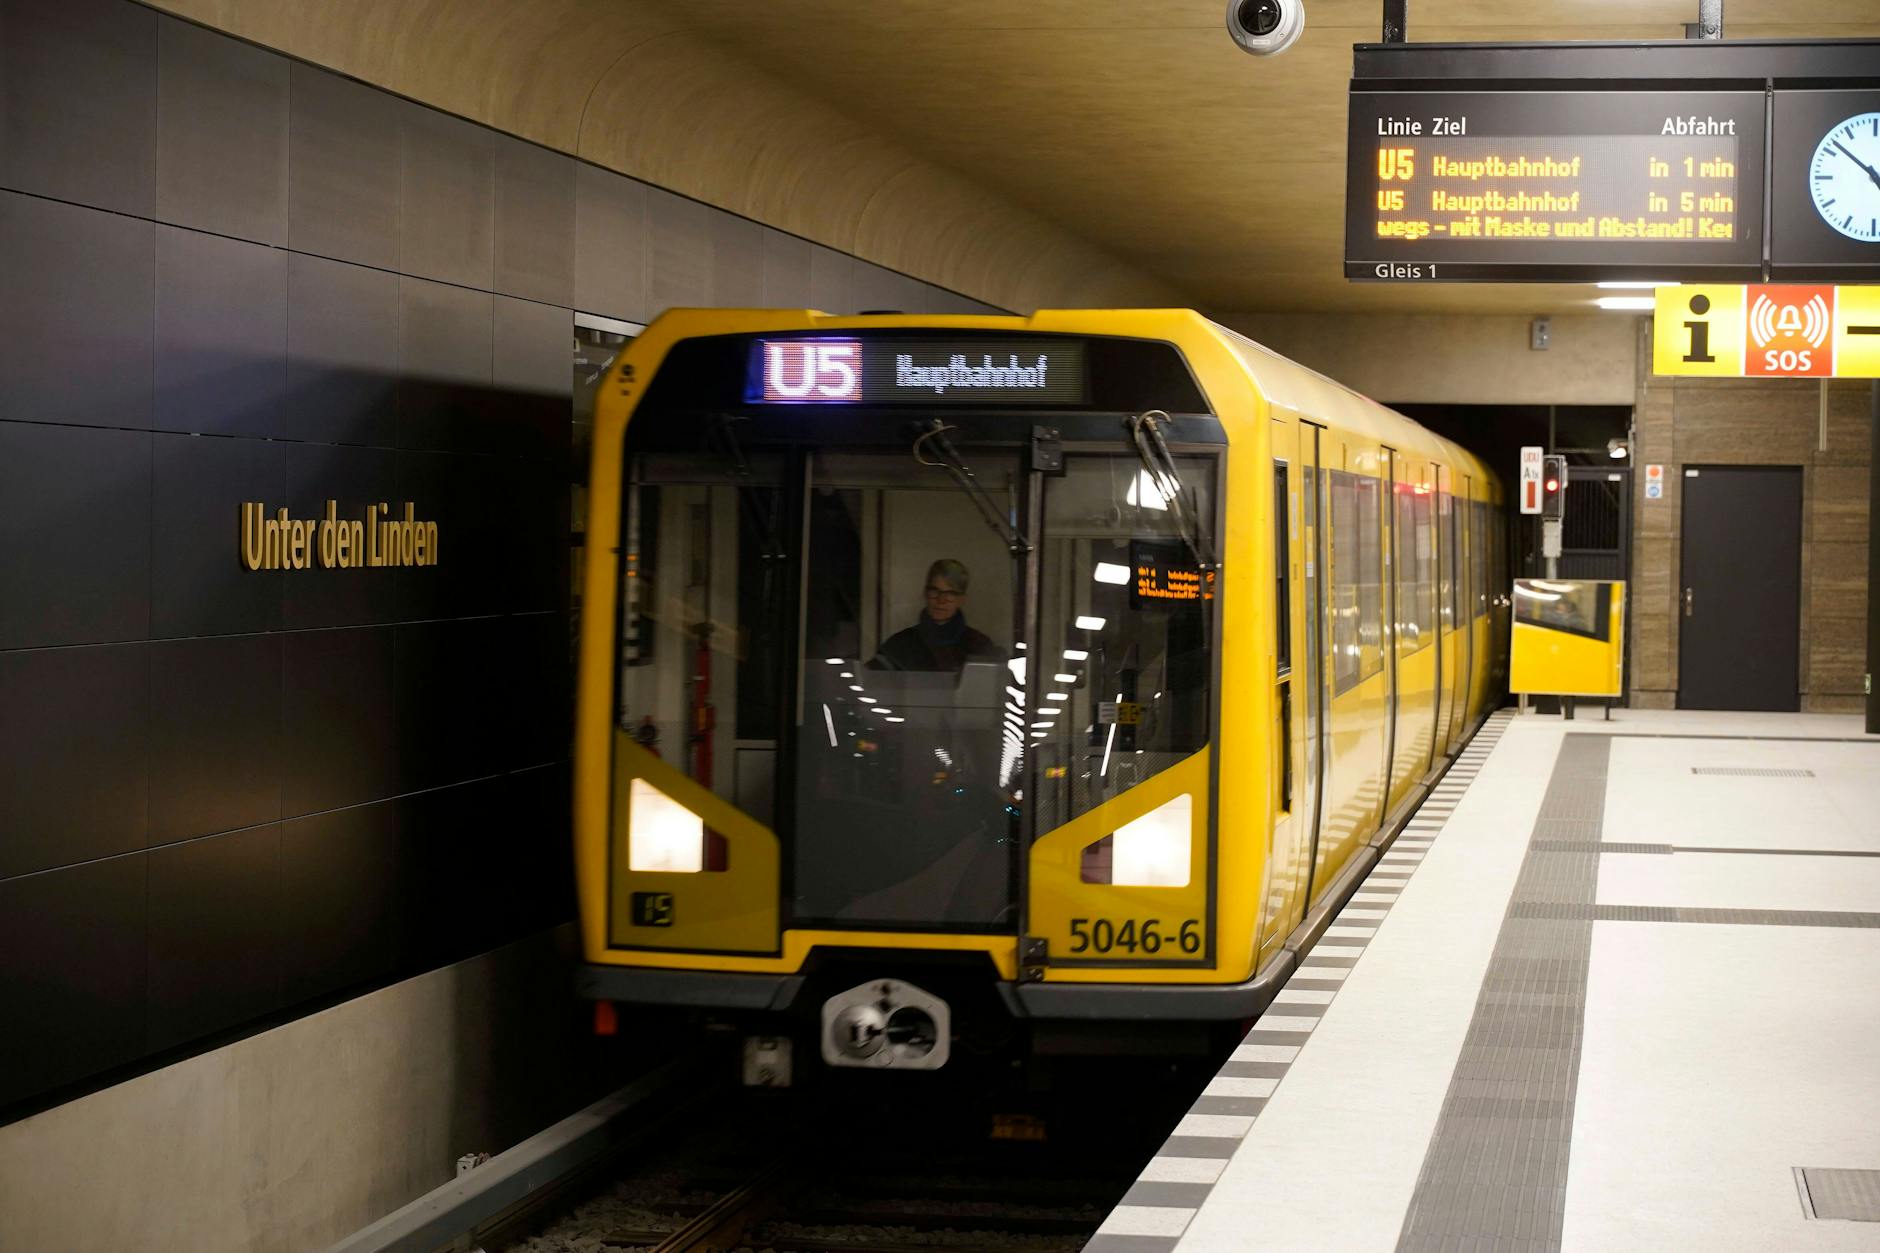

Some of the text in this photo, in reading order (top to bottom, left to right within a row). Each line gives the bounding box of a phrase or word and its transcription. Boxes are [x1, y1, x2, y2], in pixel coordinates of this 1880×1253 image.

[1378, 116, 1736, 135] Linie Ziel Abfahrt
[1378, 149, 1735, 180] U5 Hauptbahnhof in 1 min
[1377, 190, 1734, 214] U5 Hauptbahnhof in 5 min
[1377, 221, 1431, 240] wegs
[1450, 216, 1481, 237] mit
[1485, 216, 1551, 237] Maske
[1554, 217, 1595, 237] und
[1599, 217, 1694, 238] Abstand!
[1375, 263, 1436, 279] Gleis 1
[768, 346, 1048, 398] U5 Hauptbahnhof
[1764, 350, 1812, 371] SOS
[241, 499, 438, 571] Unter den Linden
[1070, 918, 1201, 954] 5046-6
